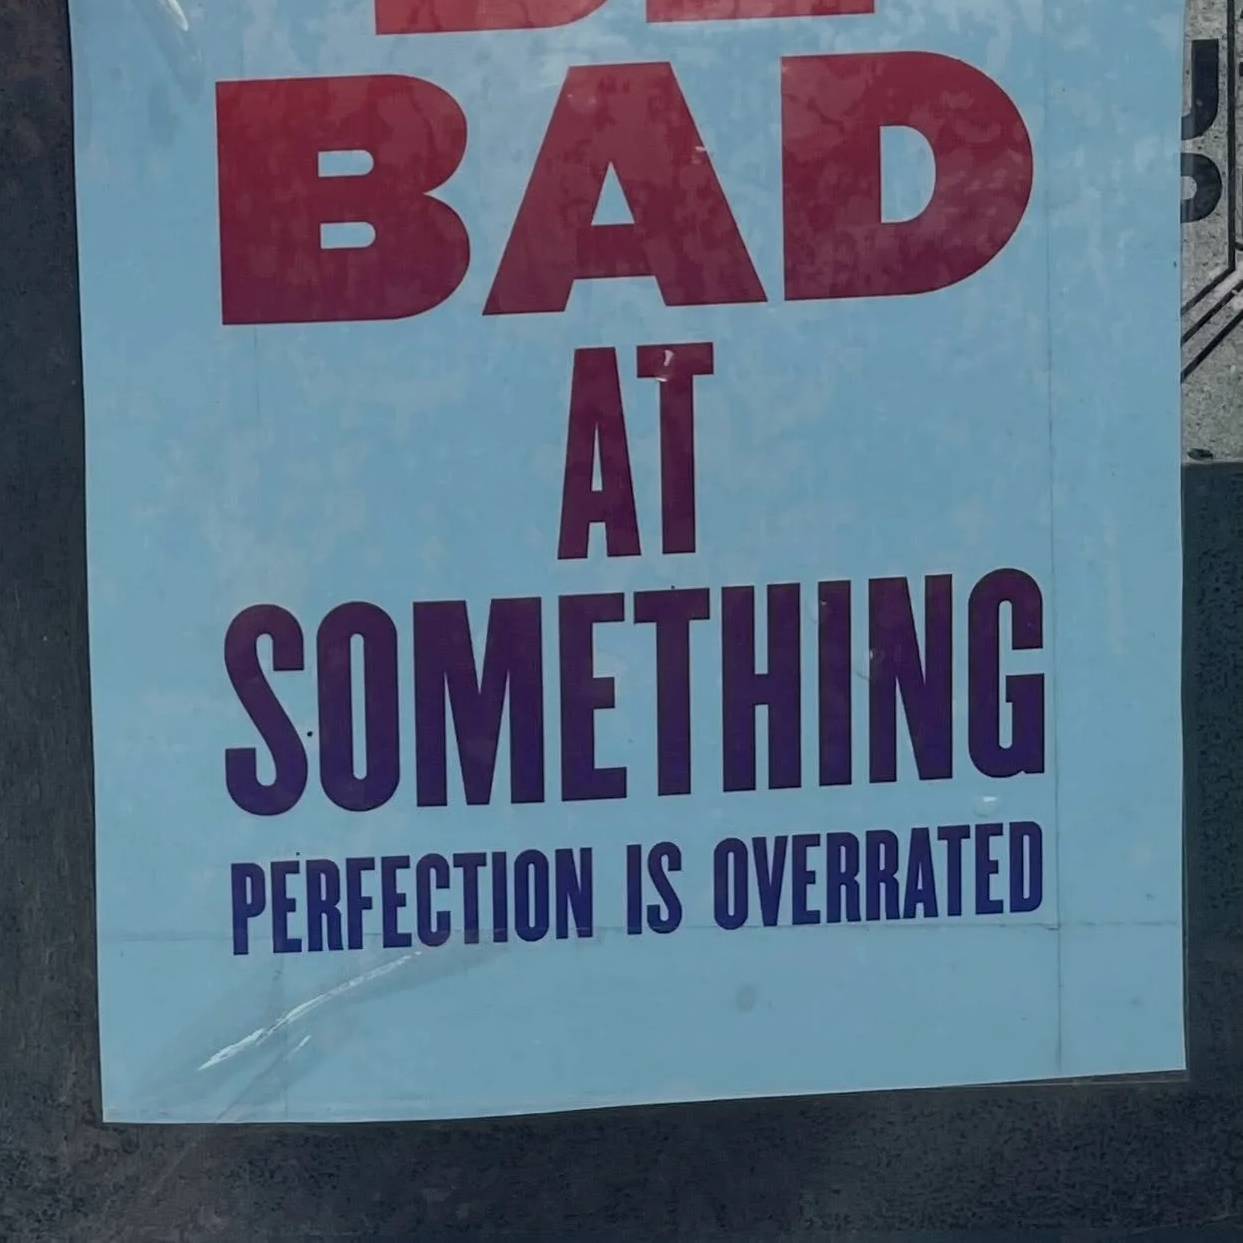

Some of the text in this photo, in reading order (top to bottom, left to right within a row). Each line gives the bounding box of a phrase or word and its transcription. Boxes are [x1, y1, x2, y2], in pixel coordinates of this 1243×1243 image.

[215, 51, 1034, 326] BAD
[557, 342, 715, 561] AT
[223, 567, 1046, 817] SOMETHING
[230, 820, 1044, 957] PERFECTION IS OVERRATED
